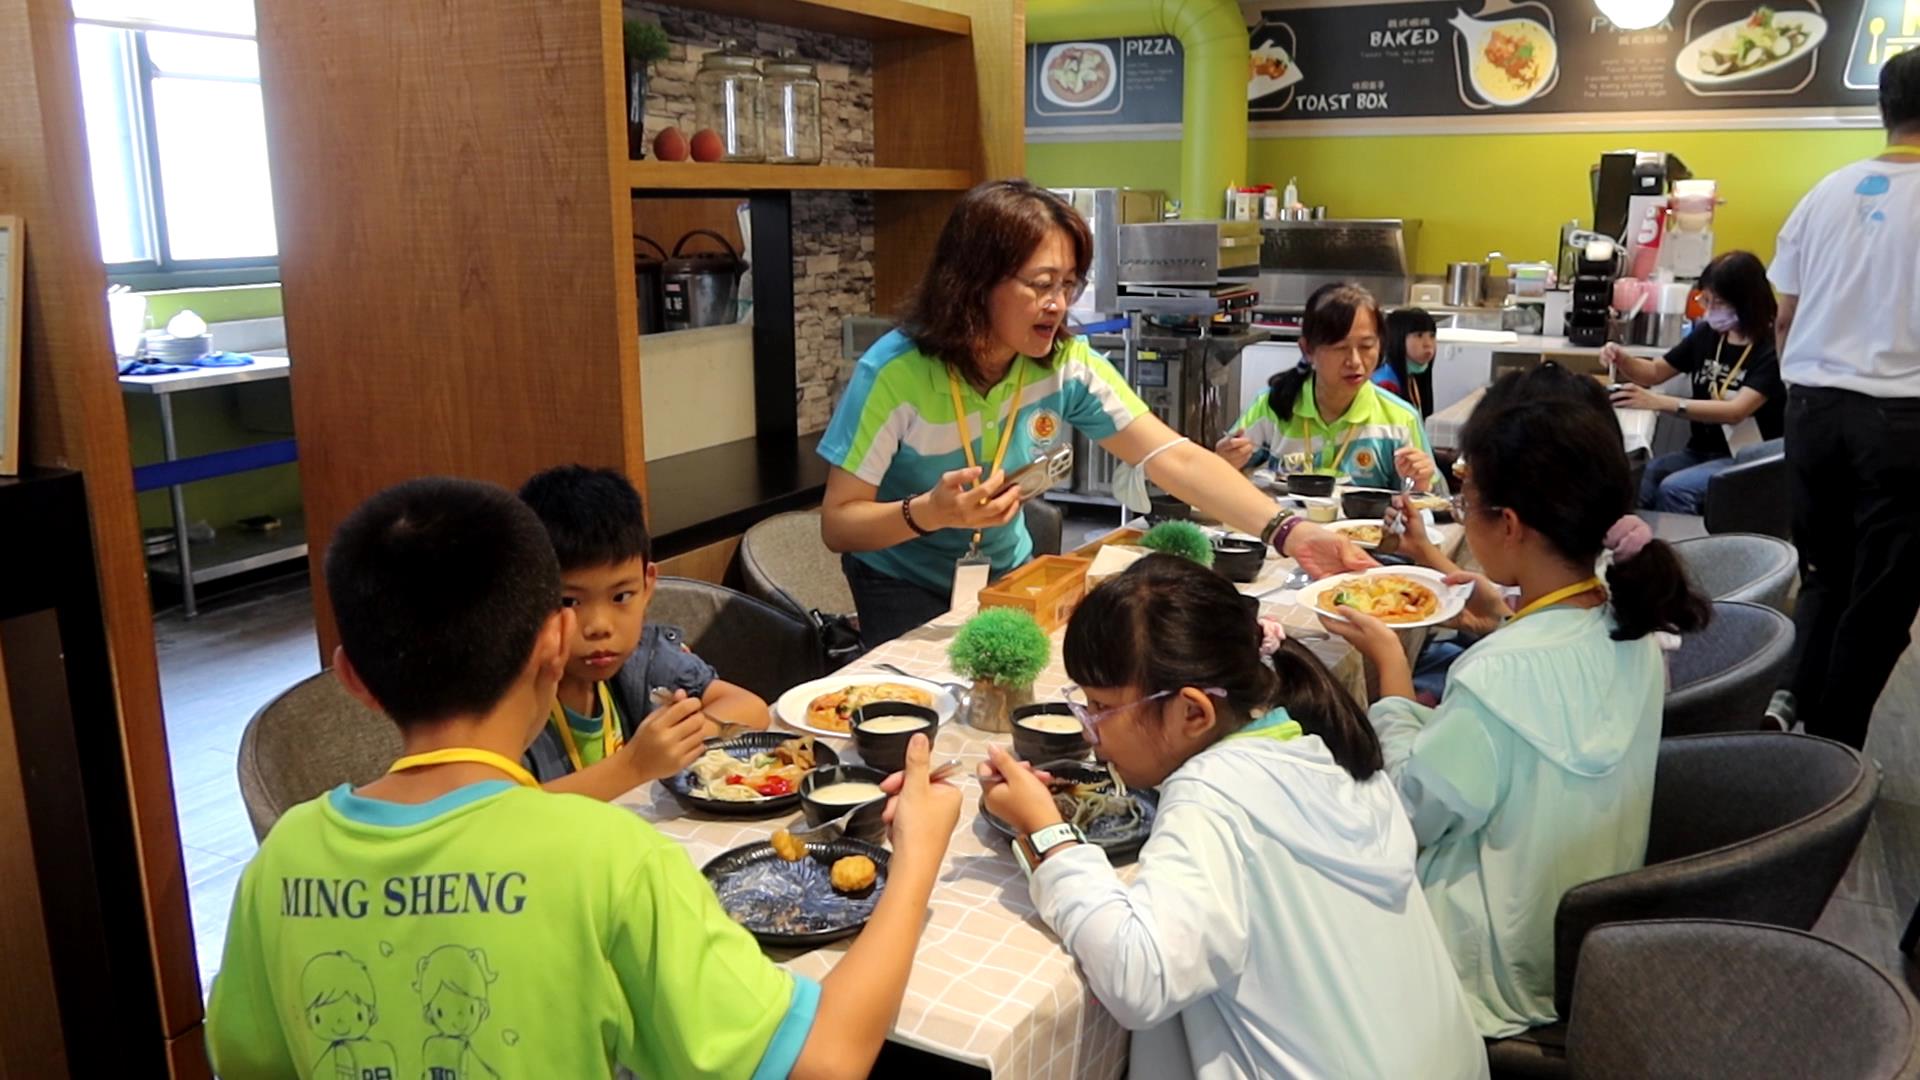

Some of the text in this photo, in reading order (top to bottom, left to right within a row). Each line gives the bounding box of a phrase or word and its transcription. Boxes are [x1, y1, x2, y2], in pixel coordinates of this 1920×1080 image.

[1126, 38, 1175, 56] PIZZA
[1370, 28, 1440, 47] BAKED
[1295, 91, 1388, 112] TOAST BOX
[280, 871, 527, 918] MING SHENG
